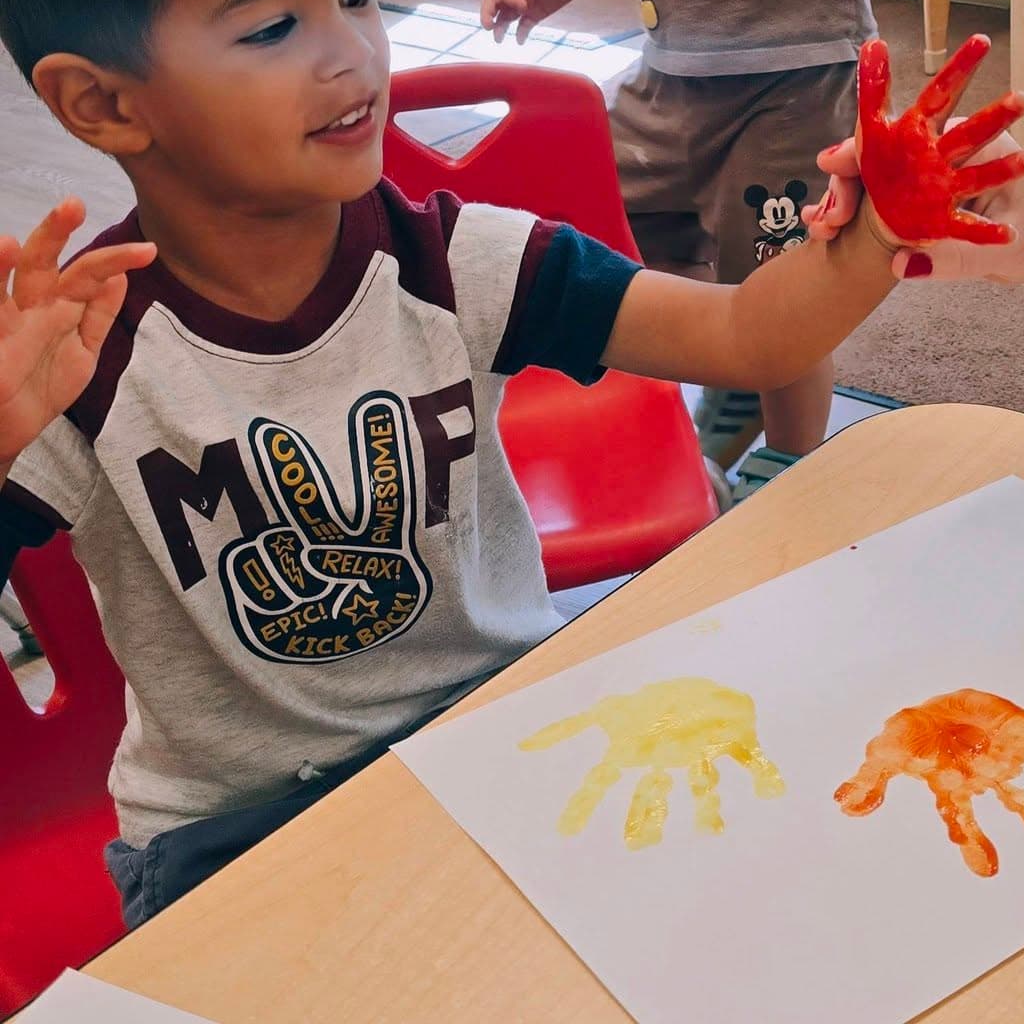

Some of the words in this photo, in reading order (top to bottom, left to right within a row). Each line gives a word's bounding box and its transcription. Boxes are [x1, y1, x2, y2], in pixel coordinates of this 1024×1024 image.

[271, 433, 344, 541] COOL!!!
[367, 413, 399, 544] AWESOME!
[322, 550, 401, 580] RELAX!
[260, 602, 328, 642] EPIC!
[285, 635, 350, 656] KICK
[356, 592, 418, 646] BACK!
